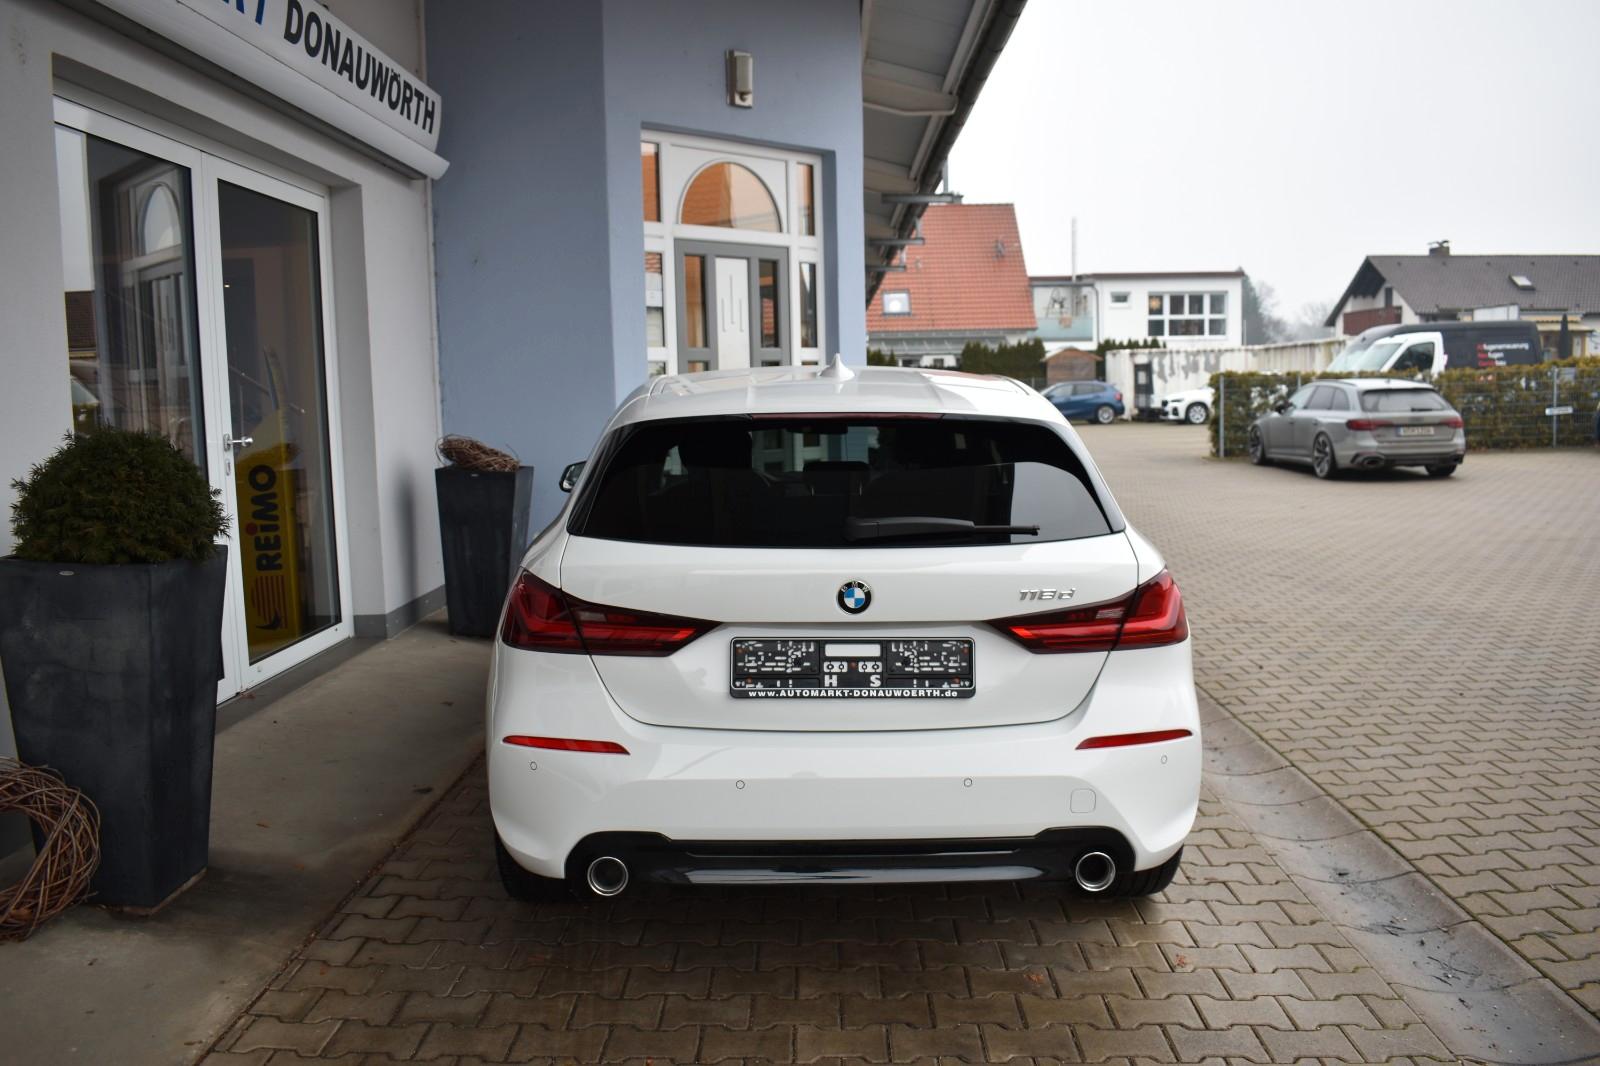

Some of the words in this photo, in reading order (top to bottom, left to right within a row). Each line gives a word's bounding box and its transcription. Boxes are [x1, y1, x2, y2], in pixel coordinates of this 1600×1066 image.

[284, 0, 436, 134] DONAUWÖRTH
[1020, 587, 1076, 601] 118d
[824, 675, 837, 687] H
[870, 675, 881, 687] S
[748, 689, 958, 697] www.AUTOMARKT-DONAUWOERTH.de
